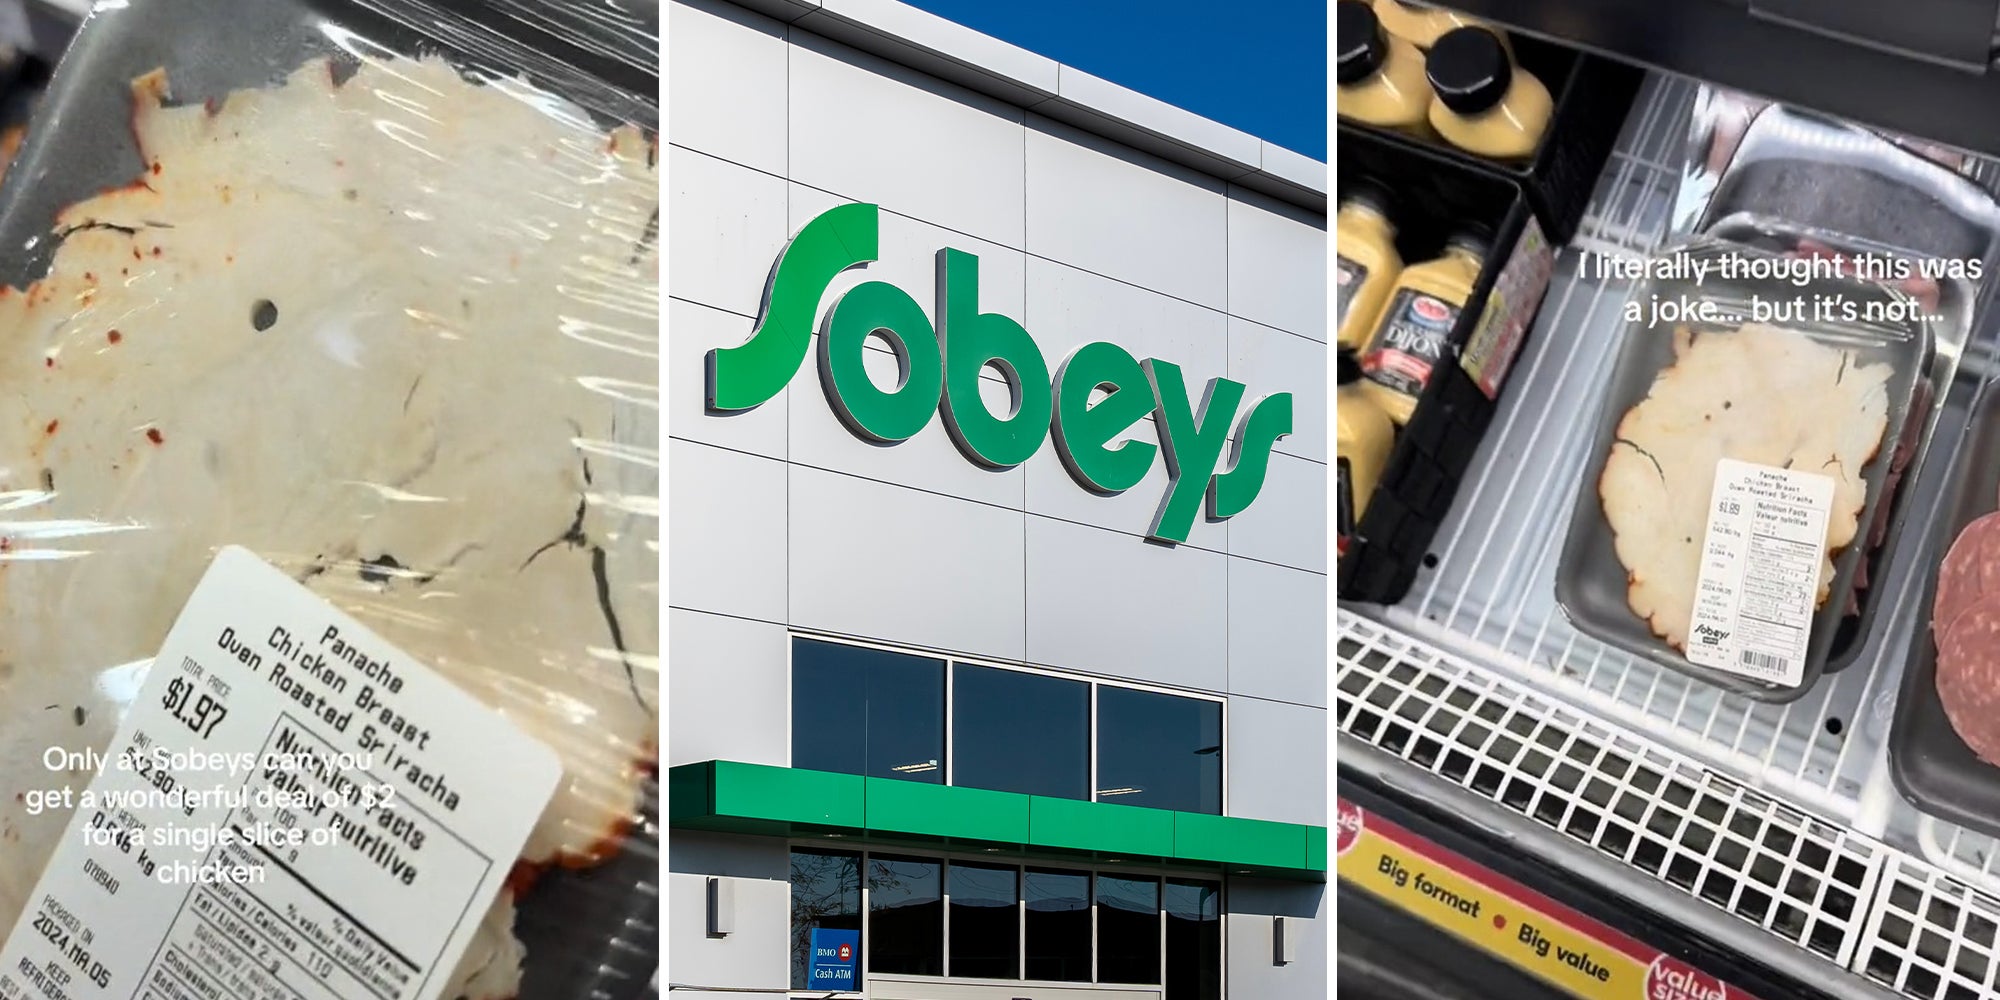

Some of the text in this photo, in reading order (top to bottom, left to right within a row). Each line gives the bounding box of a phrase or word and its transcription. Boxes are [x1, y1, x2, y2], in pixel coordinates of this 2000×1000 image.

[705, 202, 1293, 546] Sobeys
[1757, 501, 1787, 514] Nutrition
[1694, 624, 1731, 640] Sobeys
[320, 625, 404, 694] Panache
[162, 676, 228, 740] $1.97
[207, 674, 233, 699] PRICE
[268, 626, 431, 751] Chicken Breast
[217, 626, 461, 812] Oven Roasted Sriracha
[137, 848, 156, 877] kg
[328, 811, 418, 887] nutritive
[193, 893, 213, 914] Fat
[218, 911, 257, 949] Lipides
[300, 915, 335, 949] valeur
[1378, 854, 1610, 982] Big format Big value
[252, 909, 297, 952] Calories
[307, 950, 334, 980] 110
[345, 927, 375, 961] Daily
[817, 948, 836, 957] BMO
[45, 960, 72, 986] KEEP
[815, 968, 851, 979] Cash ATM
